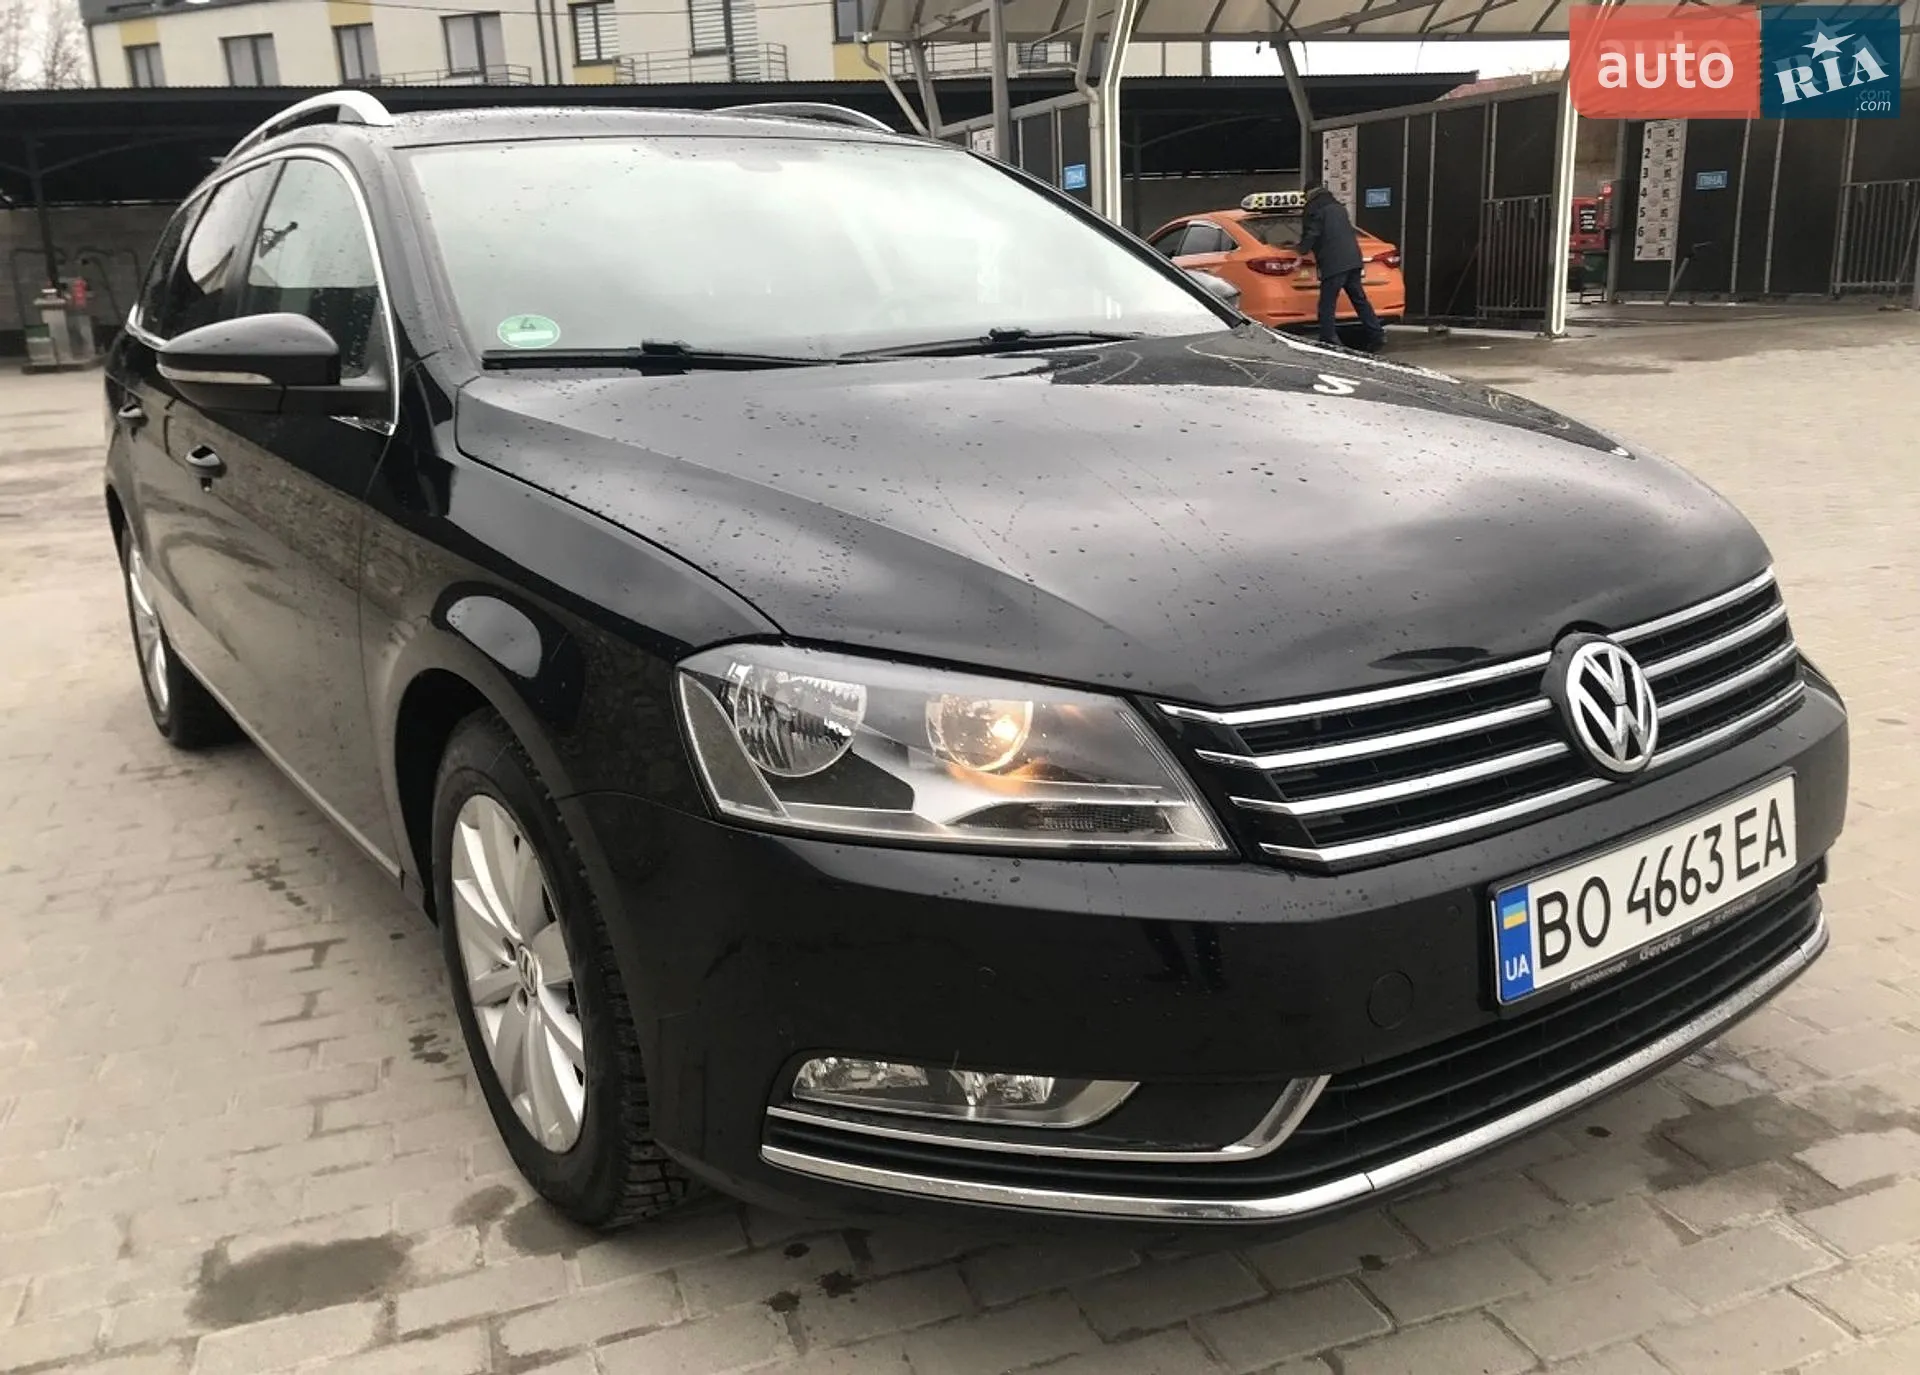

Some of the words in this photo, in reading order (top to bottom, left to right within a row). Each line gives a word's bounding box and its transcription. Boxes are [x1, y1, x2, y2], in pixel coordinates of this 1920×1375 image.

[1536, 876, 1612, 969] BO
[1627, 823, 1724, 925] 4663
[1735, 797, 1787, 882] EA
[1504, 953, 1531, 981] UA
